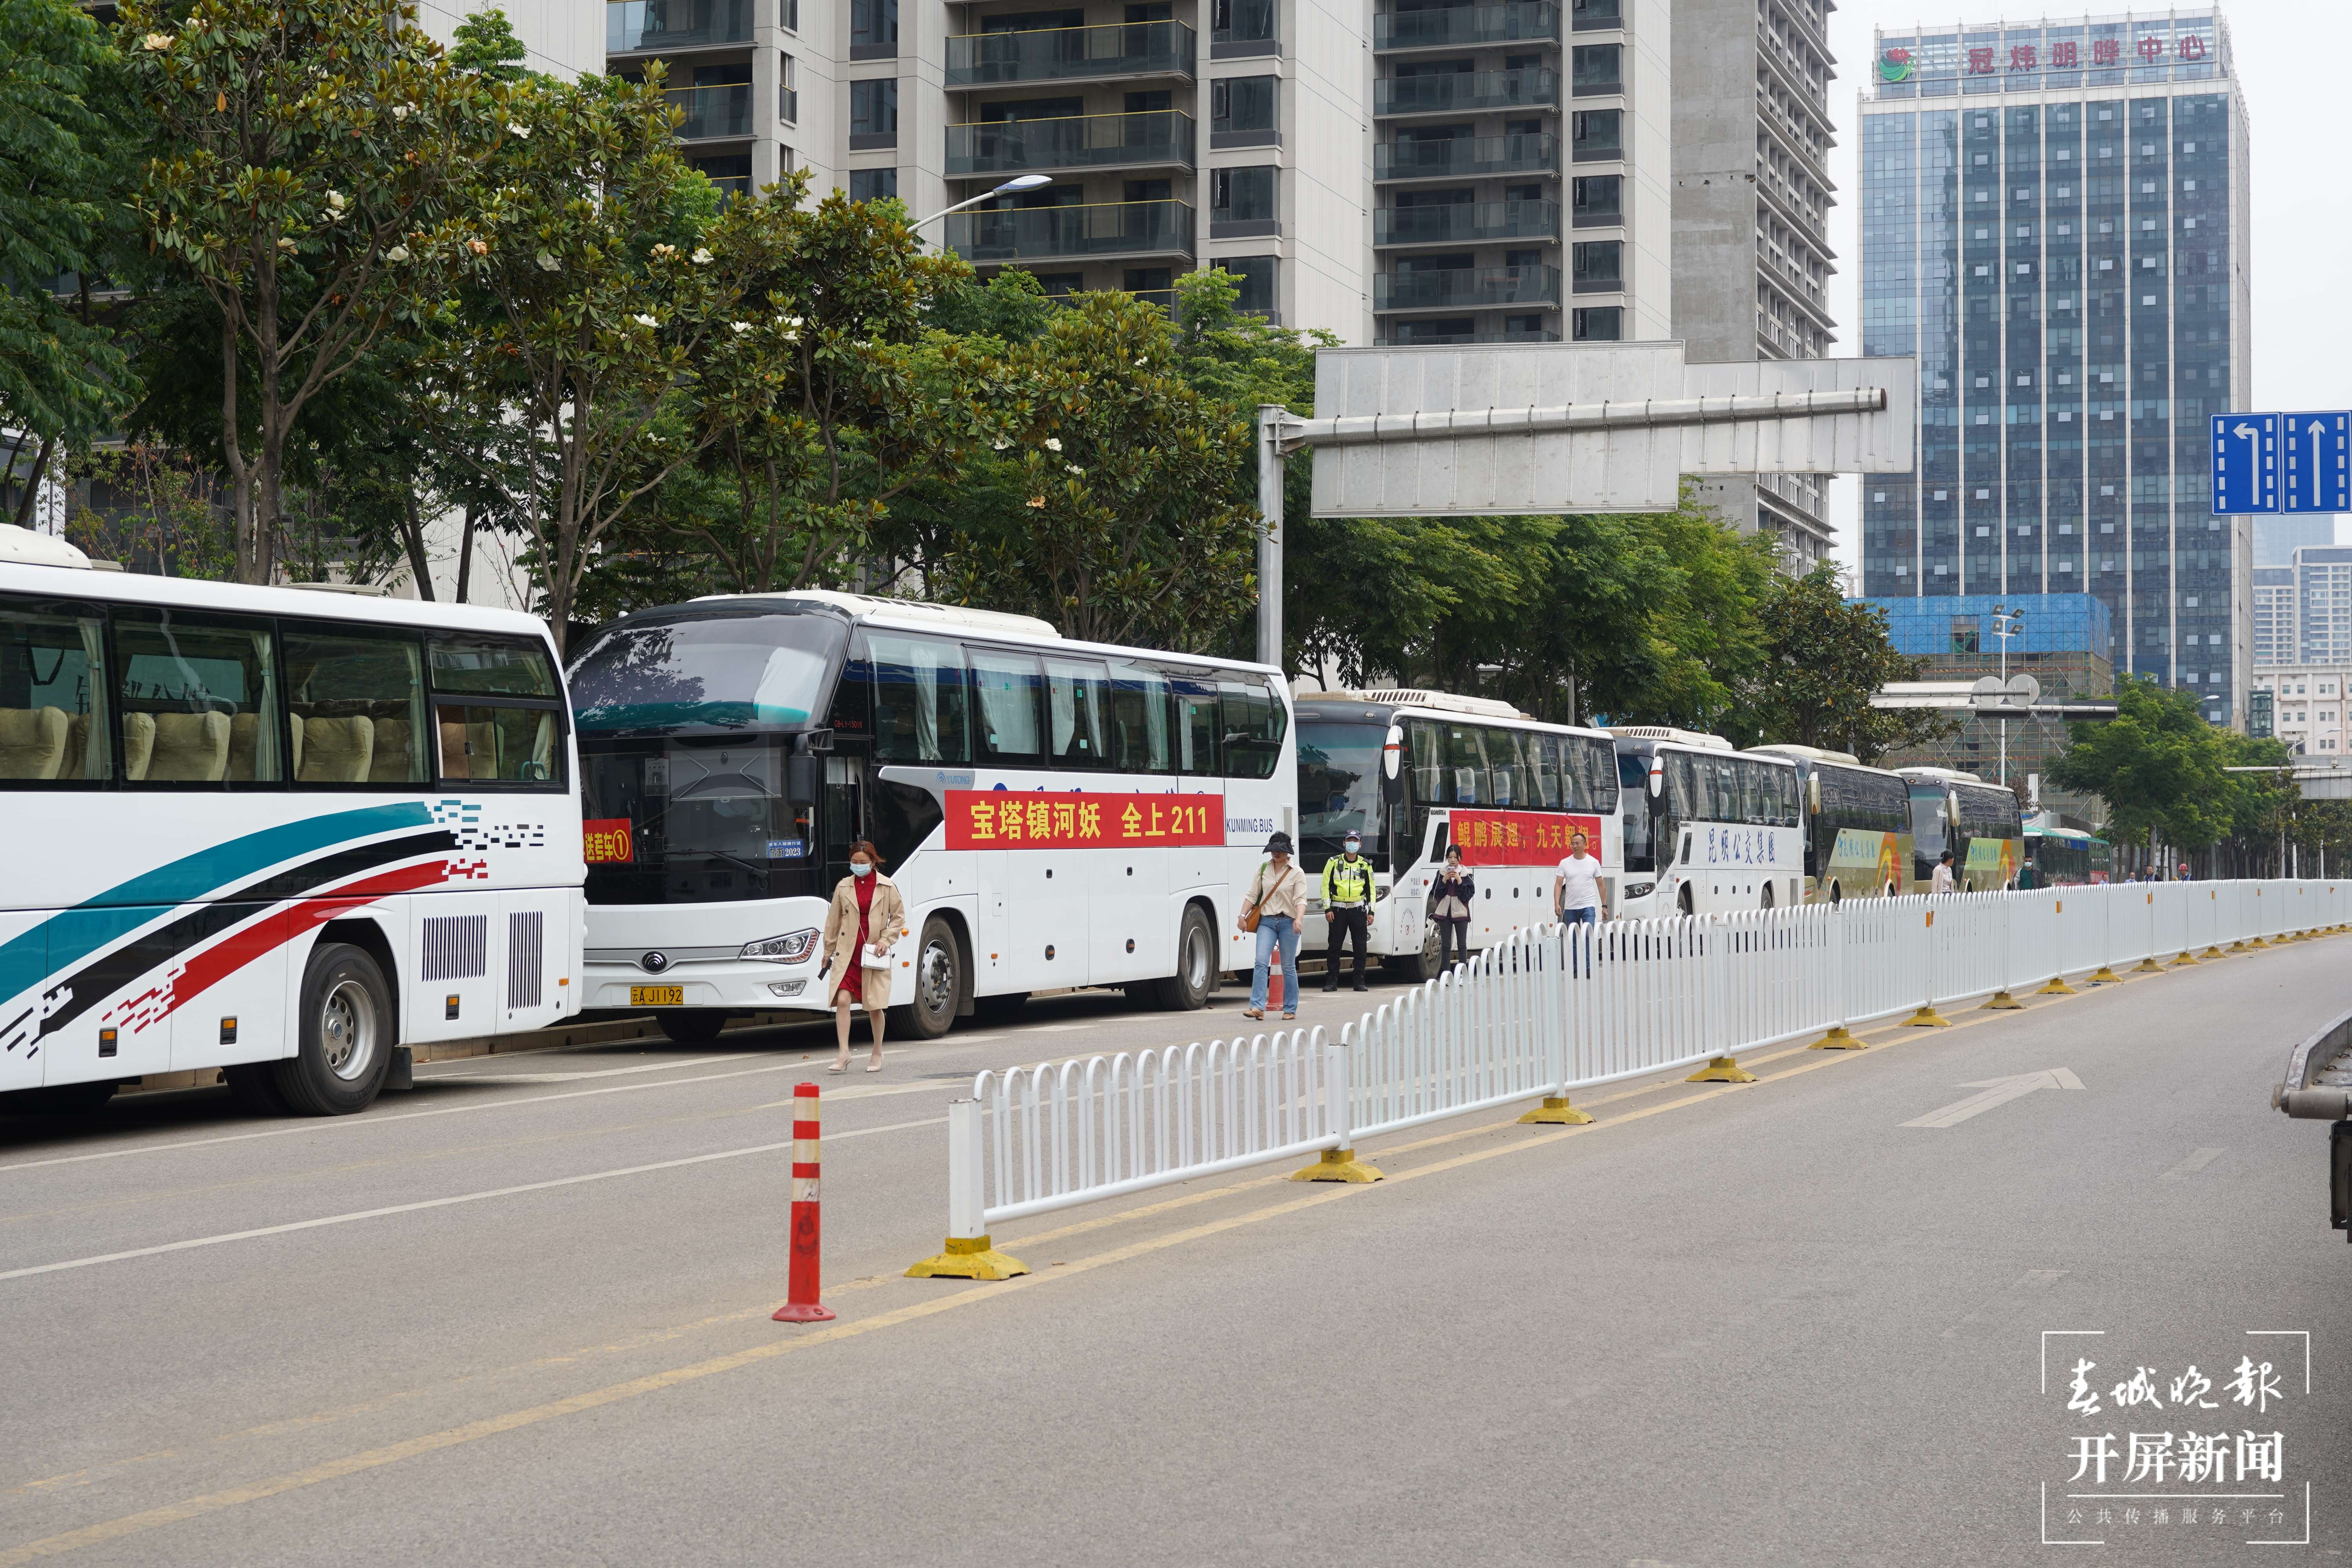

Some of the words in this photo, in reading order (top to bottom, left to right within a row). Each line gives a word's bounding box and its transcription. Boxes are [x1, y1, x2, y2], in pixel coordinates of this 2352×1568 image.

[1968, 34, 2207, 74] 冠炜明晔中心
[947, 775, 970, 784] YUTONG
[971, 800, 1101, 840] 宝塔镇河妖
[1121, 802, 1206, 837] 全上211
[1227, 818, 1258, 833] KUNMING
[1259, 818, 1273, 833] BUS
[584, 829, 629, 860] 送考车①
[785, 848, 801, 857] 2023
